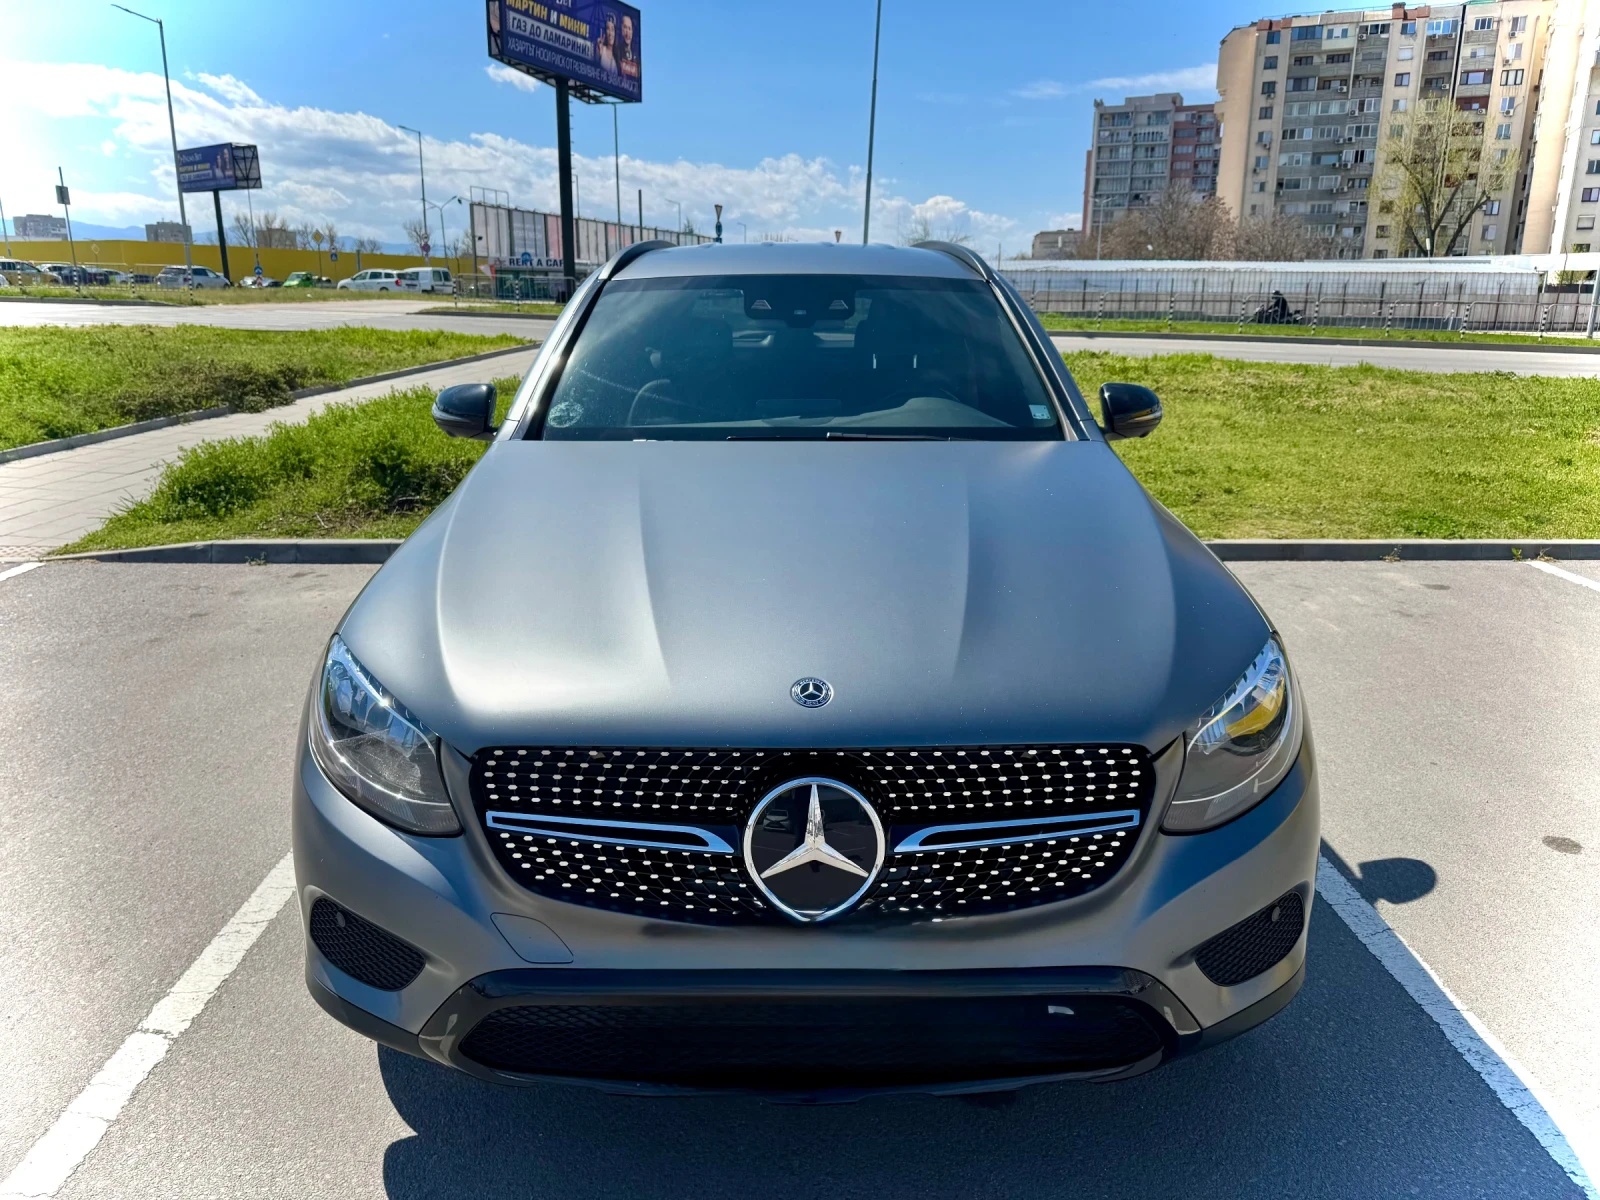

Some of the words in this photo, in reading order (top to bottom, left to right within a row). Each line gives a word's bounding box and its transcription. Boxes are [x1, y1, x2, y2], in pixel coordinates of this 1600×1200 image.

[511, 16, 527, 32] ГАЗ
[529, 23, 541, 39] ДО
[543, 29, 591, 56] ЛАМАРИНИ!
[550, 9, 558, 24] И
[559, 13, 590, 38] МИНИ!
[536, 259, 543, 267] A
